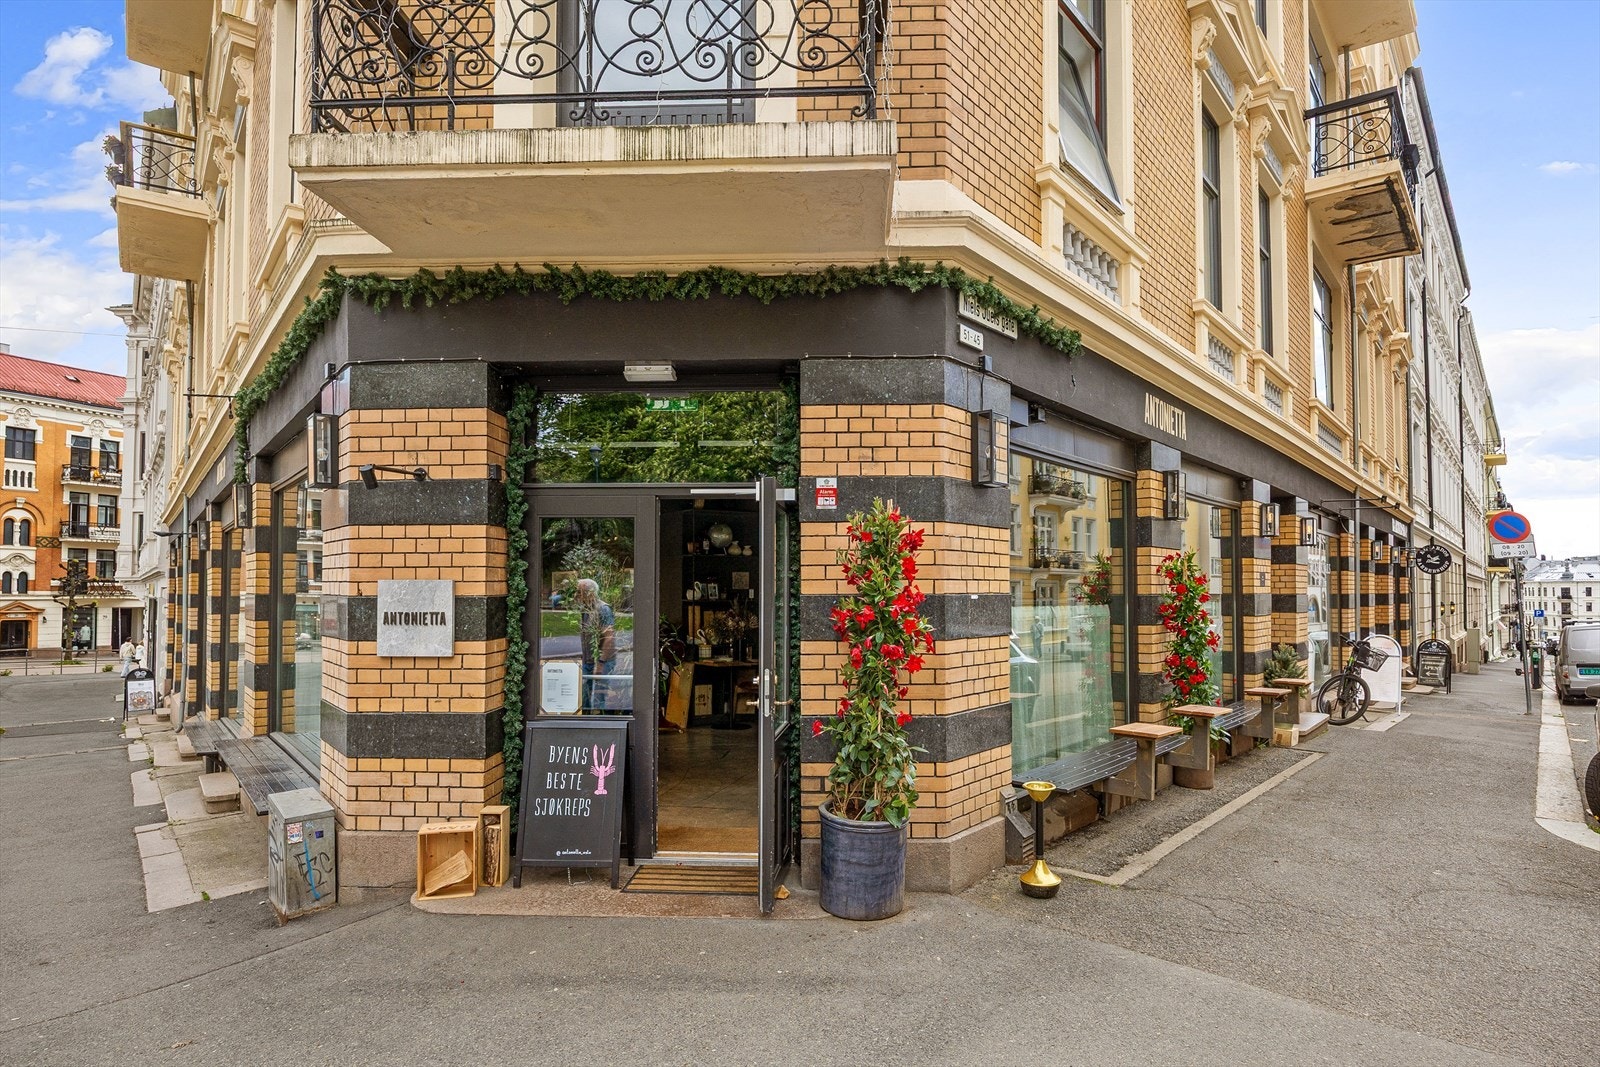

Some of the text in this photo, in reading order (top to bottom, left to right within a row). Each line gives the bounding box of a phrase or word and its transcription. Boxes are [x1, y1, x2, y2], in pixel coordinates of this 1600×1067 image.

[1144, 392, 1187, 441] ANTONIETTA
[383, 612, 446, 626] ANTONIETTA
[549, 745, 589, 765] BYENS
[546, 772, 584, 790] BESTE
[534, 797, 591, 817] SJØKREPS
